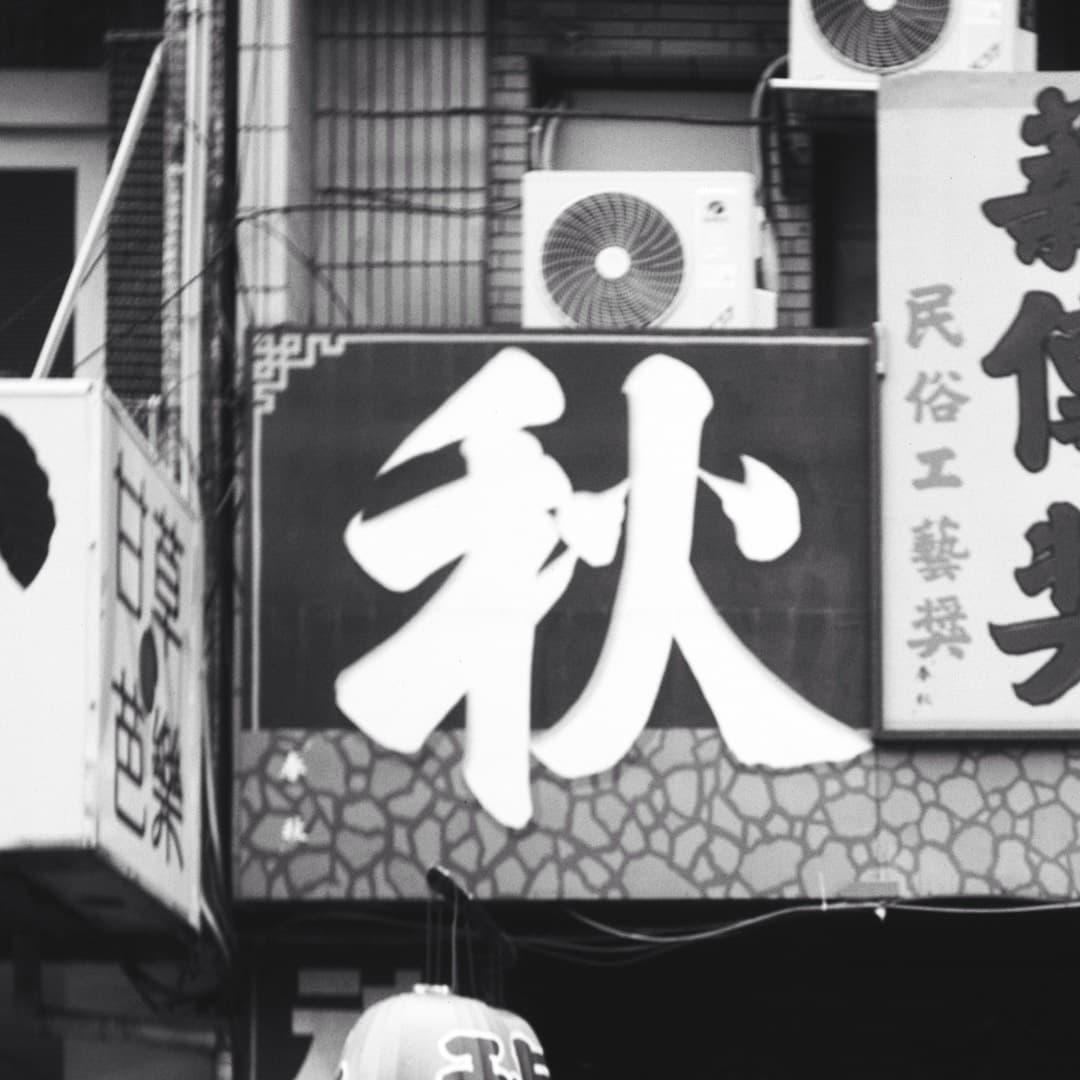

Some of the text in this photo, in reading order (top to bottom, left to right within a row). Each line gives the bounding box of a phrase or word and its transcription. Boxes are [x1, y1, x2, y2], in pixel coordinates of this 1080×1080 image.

[336, 347, 873, 828] 秋
[905, 283, 972, 660] 民俗工藝獎
